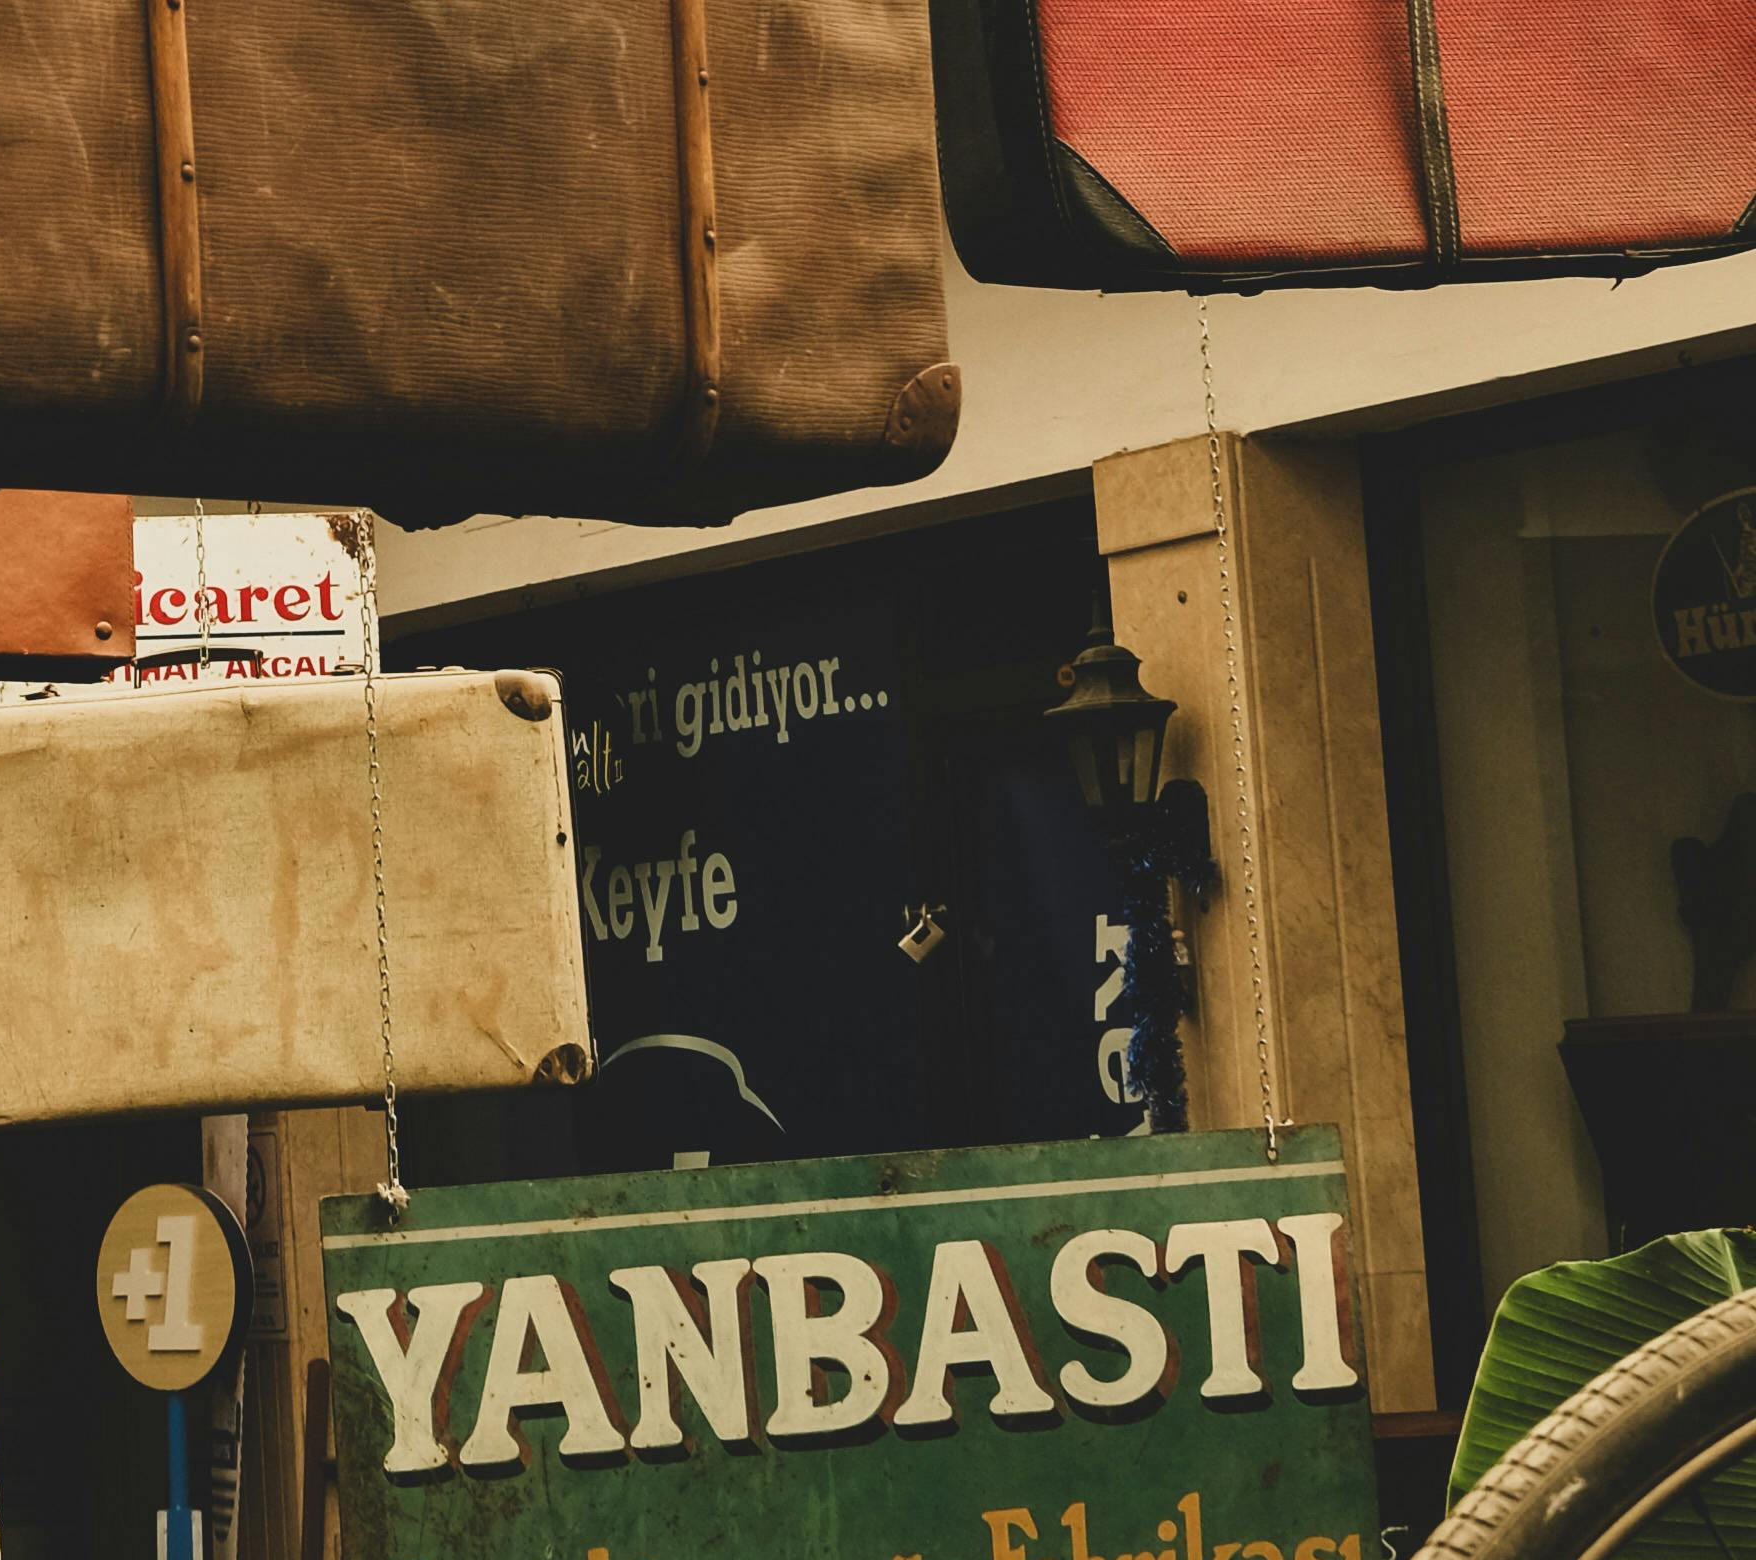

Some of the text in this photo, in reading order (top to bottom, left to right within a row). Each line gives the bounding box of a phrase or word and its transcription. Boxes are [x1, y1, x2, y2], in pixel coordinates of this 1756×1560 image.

[615, 649, 889, 758] ri gidiyor...
[582, 829, 739, 963] Keyfe
[336, 1212, 1360, 1474] YANBASTI
